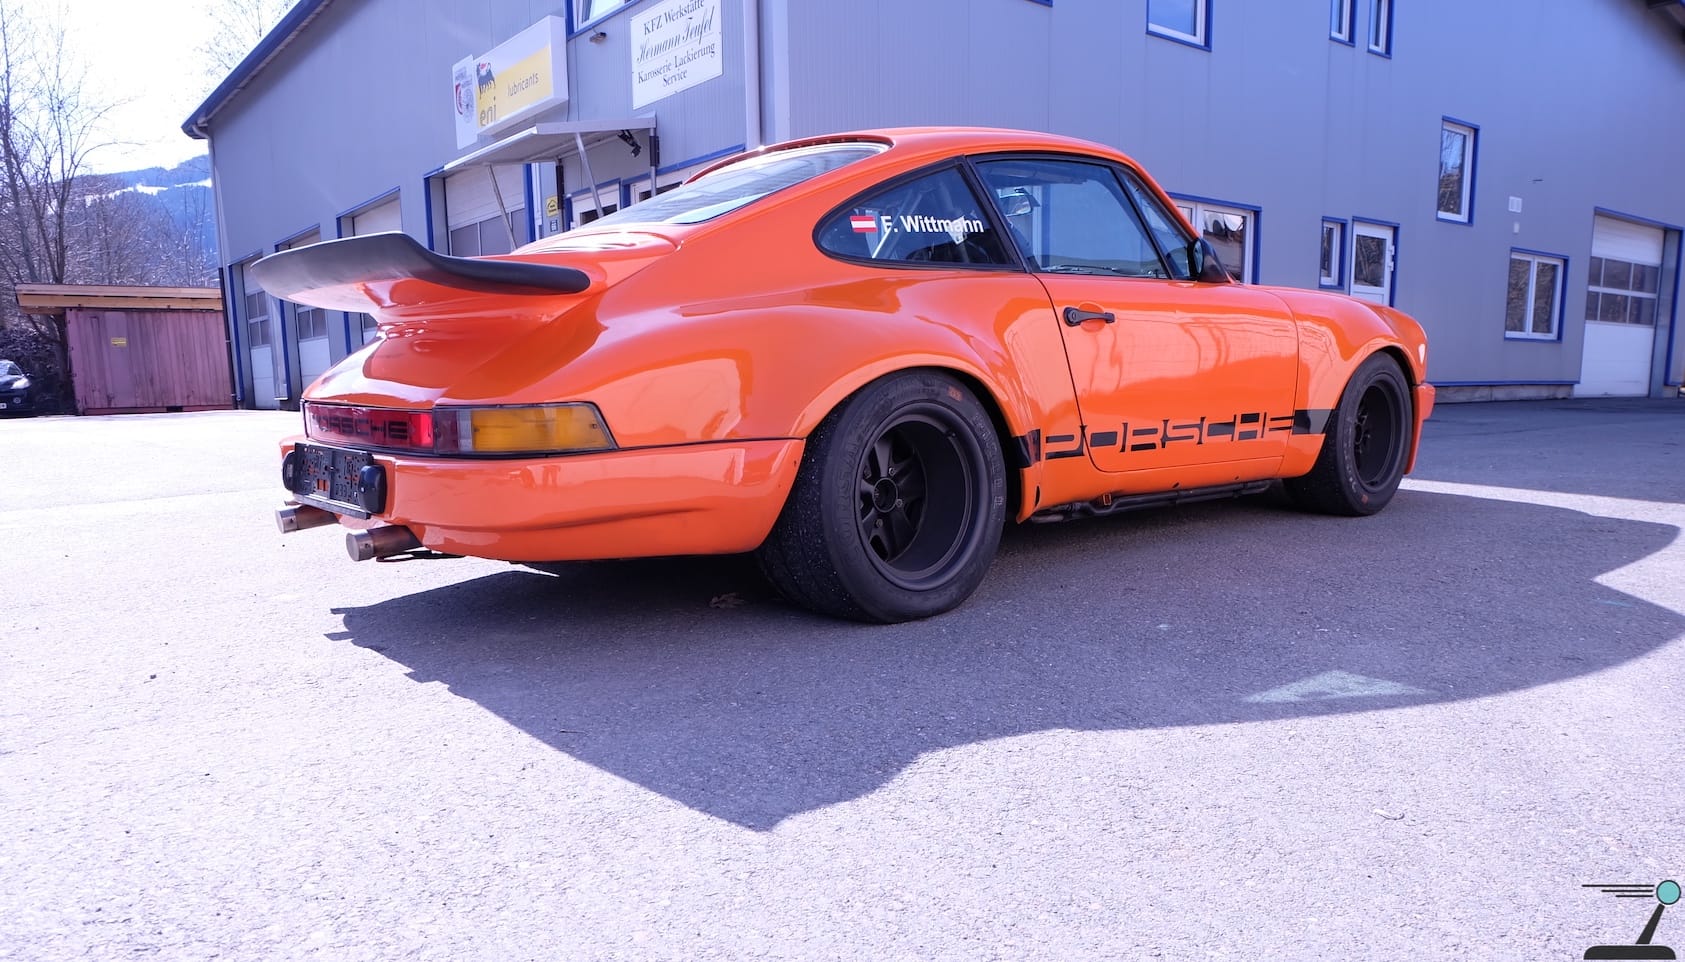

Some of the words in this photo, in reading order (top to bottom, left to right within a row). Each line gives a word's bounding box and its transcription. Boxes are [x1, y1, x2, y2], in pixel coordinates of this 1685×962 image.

[637, 34, 681, 63] Hermann
[682, 5, 715, 45] Teufel
[644, 15, 663, 36] KFZ
[638, 59, 672, 84] Karosserie
[674, 43, 715, 68] Lackierung
[507, 72, 540, 97] lubricants
[662, 68, 688, 87] Service
[480, 96, 496, 126] eni
[900, 215, 984, 233] Wittmann
[1043, 409, 1296, 461] PORSCHE
